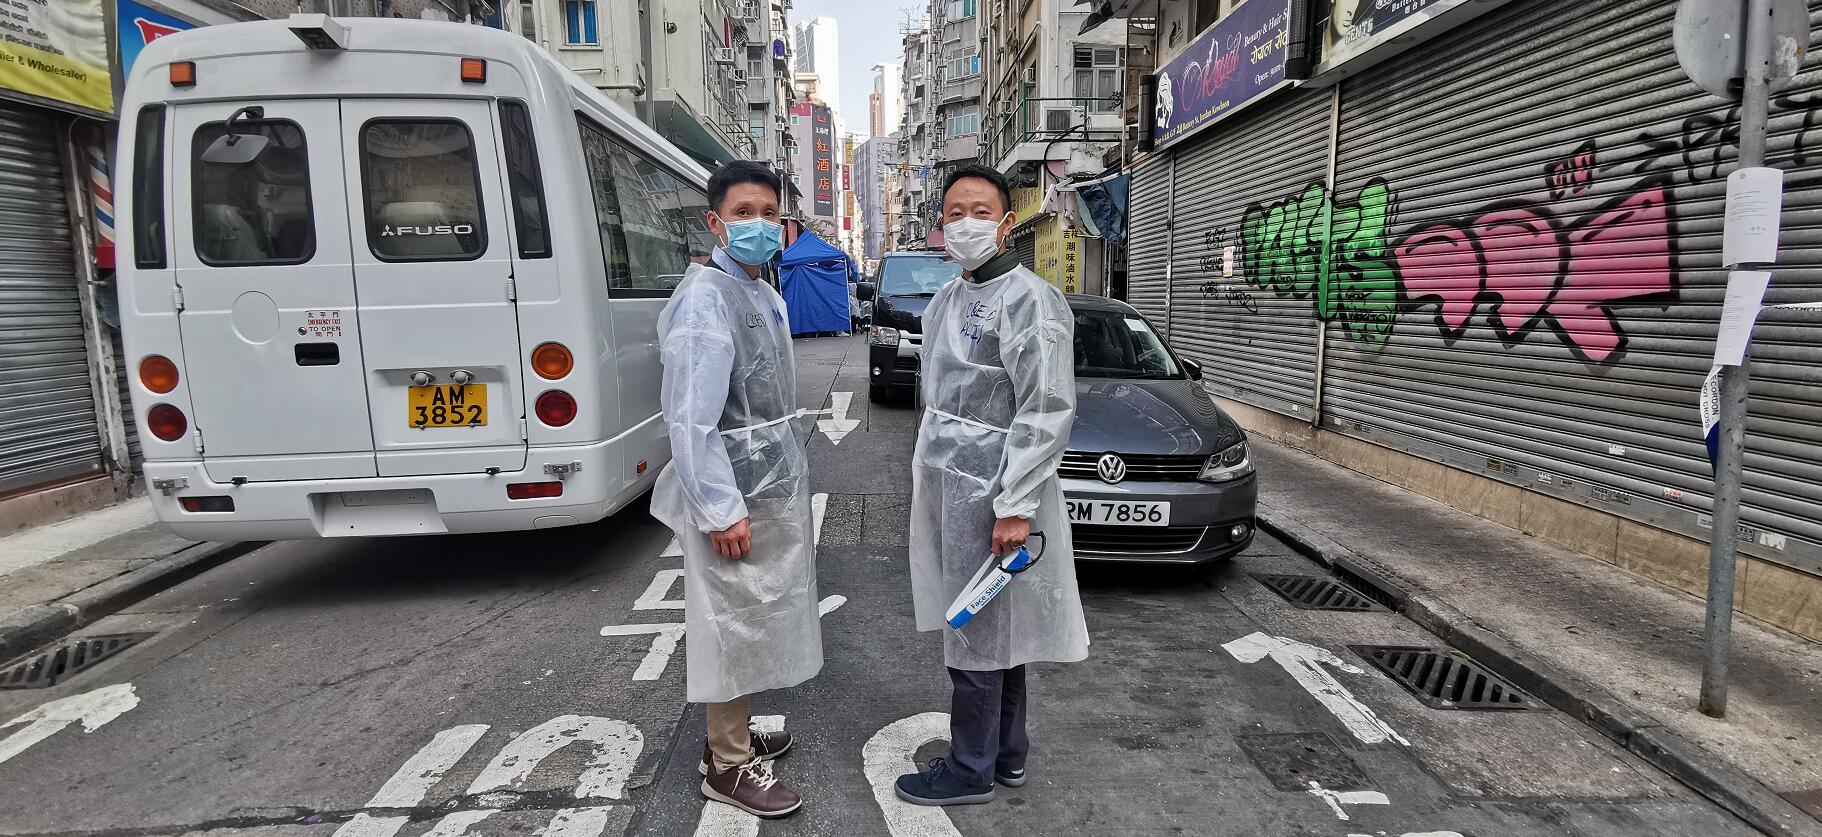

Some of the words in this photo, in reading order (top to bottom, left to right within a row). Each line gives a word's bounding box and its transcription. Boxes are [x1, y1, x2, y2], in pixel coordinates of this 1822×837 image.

[1263, 23, 1268, 34] &
[397, 225, 473, 236] FUSO
[432, 384, 465, 405] AM
[1711, 381, 1720, 416] CORDON
[415, 405, 483, 426] 3852
[1101, 504, 1162, 523] 7856
[970, 595, 987, 610] Face
[985, 575, 1006, 596] Shield
